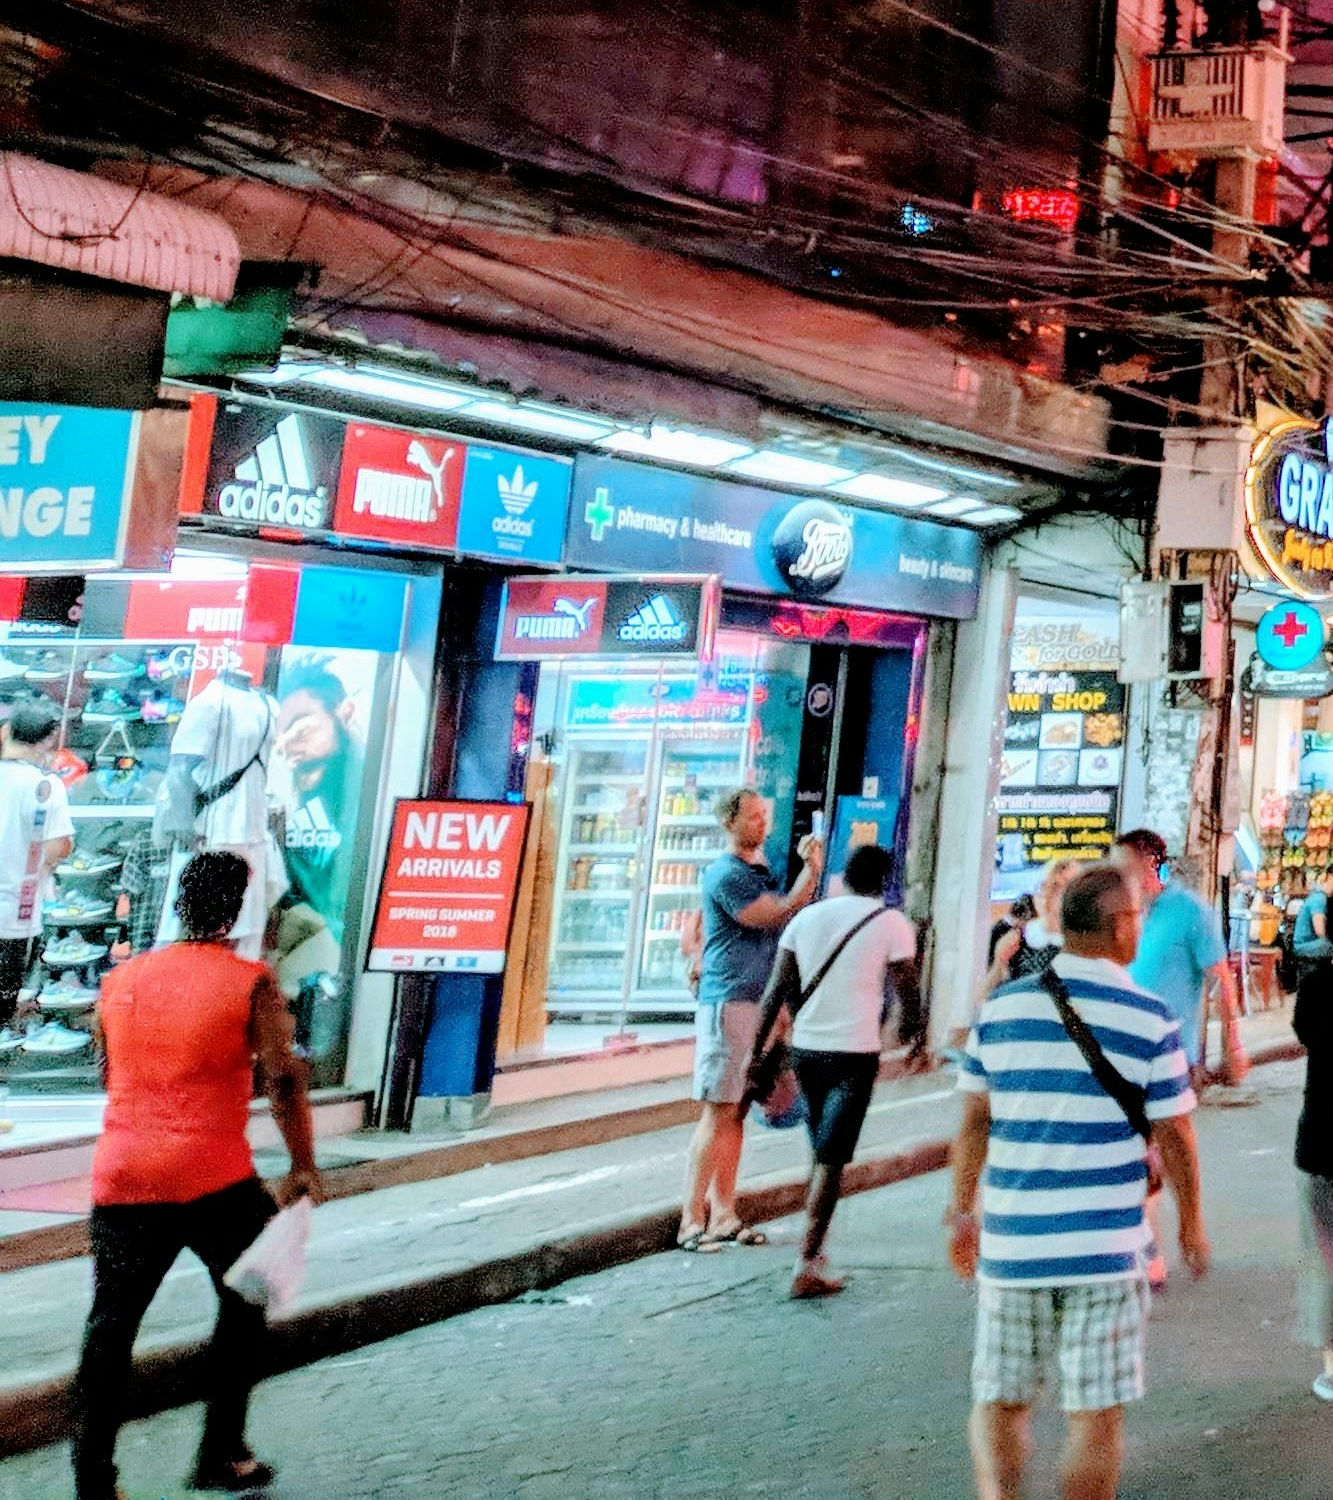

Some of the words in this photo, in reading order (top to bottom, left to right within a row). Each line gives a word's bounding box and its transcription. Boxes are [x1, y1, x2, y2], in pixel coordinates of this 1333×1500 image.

[219, 481, 326, 528] adidas
[353, 467, 434, 522] PUMA
[491, 516, 534, 536] adidas
[617, 506, 677, 536] pharmacy
[680, 517, 690, 537] &
[693, 519, 752, 549] healthcare
[788, 519, 850, 581] Boots
[514, 615, 575, 639] PUMA
[618, 622, 686, 641] adidas
[1052, 691, 1108, 712] SHOP
[402, 811, 512, 852] NEW
[397, 857, 502, 879] ARRIVALS
[388, 906, 437, 921] SPRING
[438, 907, 496, 923] SUMMER
[421, 923, 458, 939] 2018
